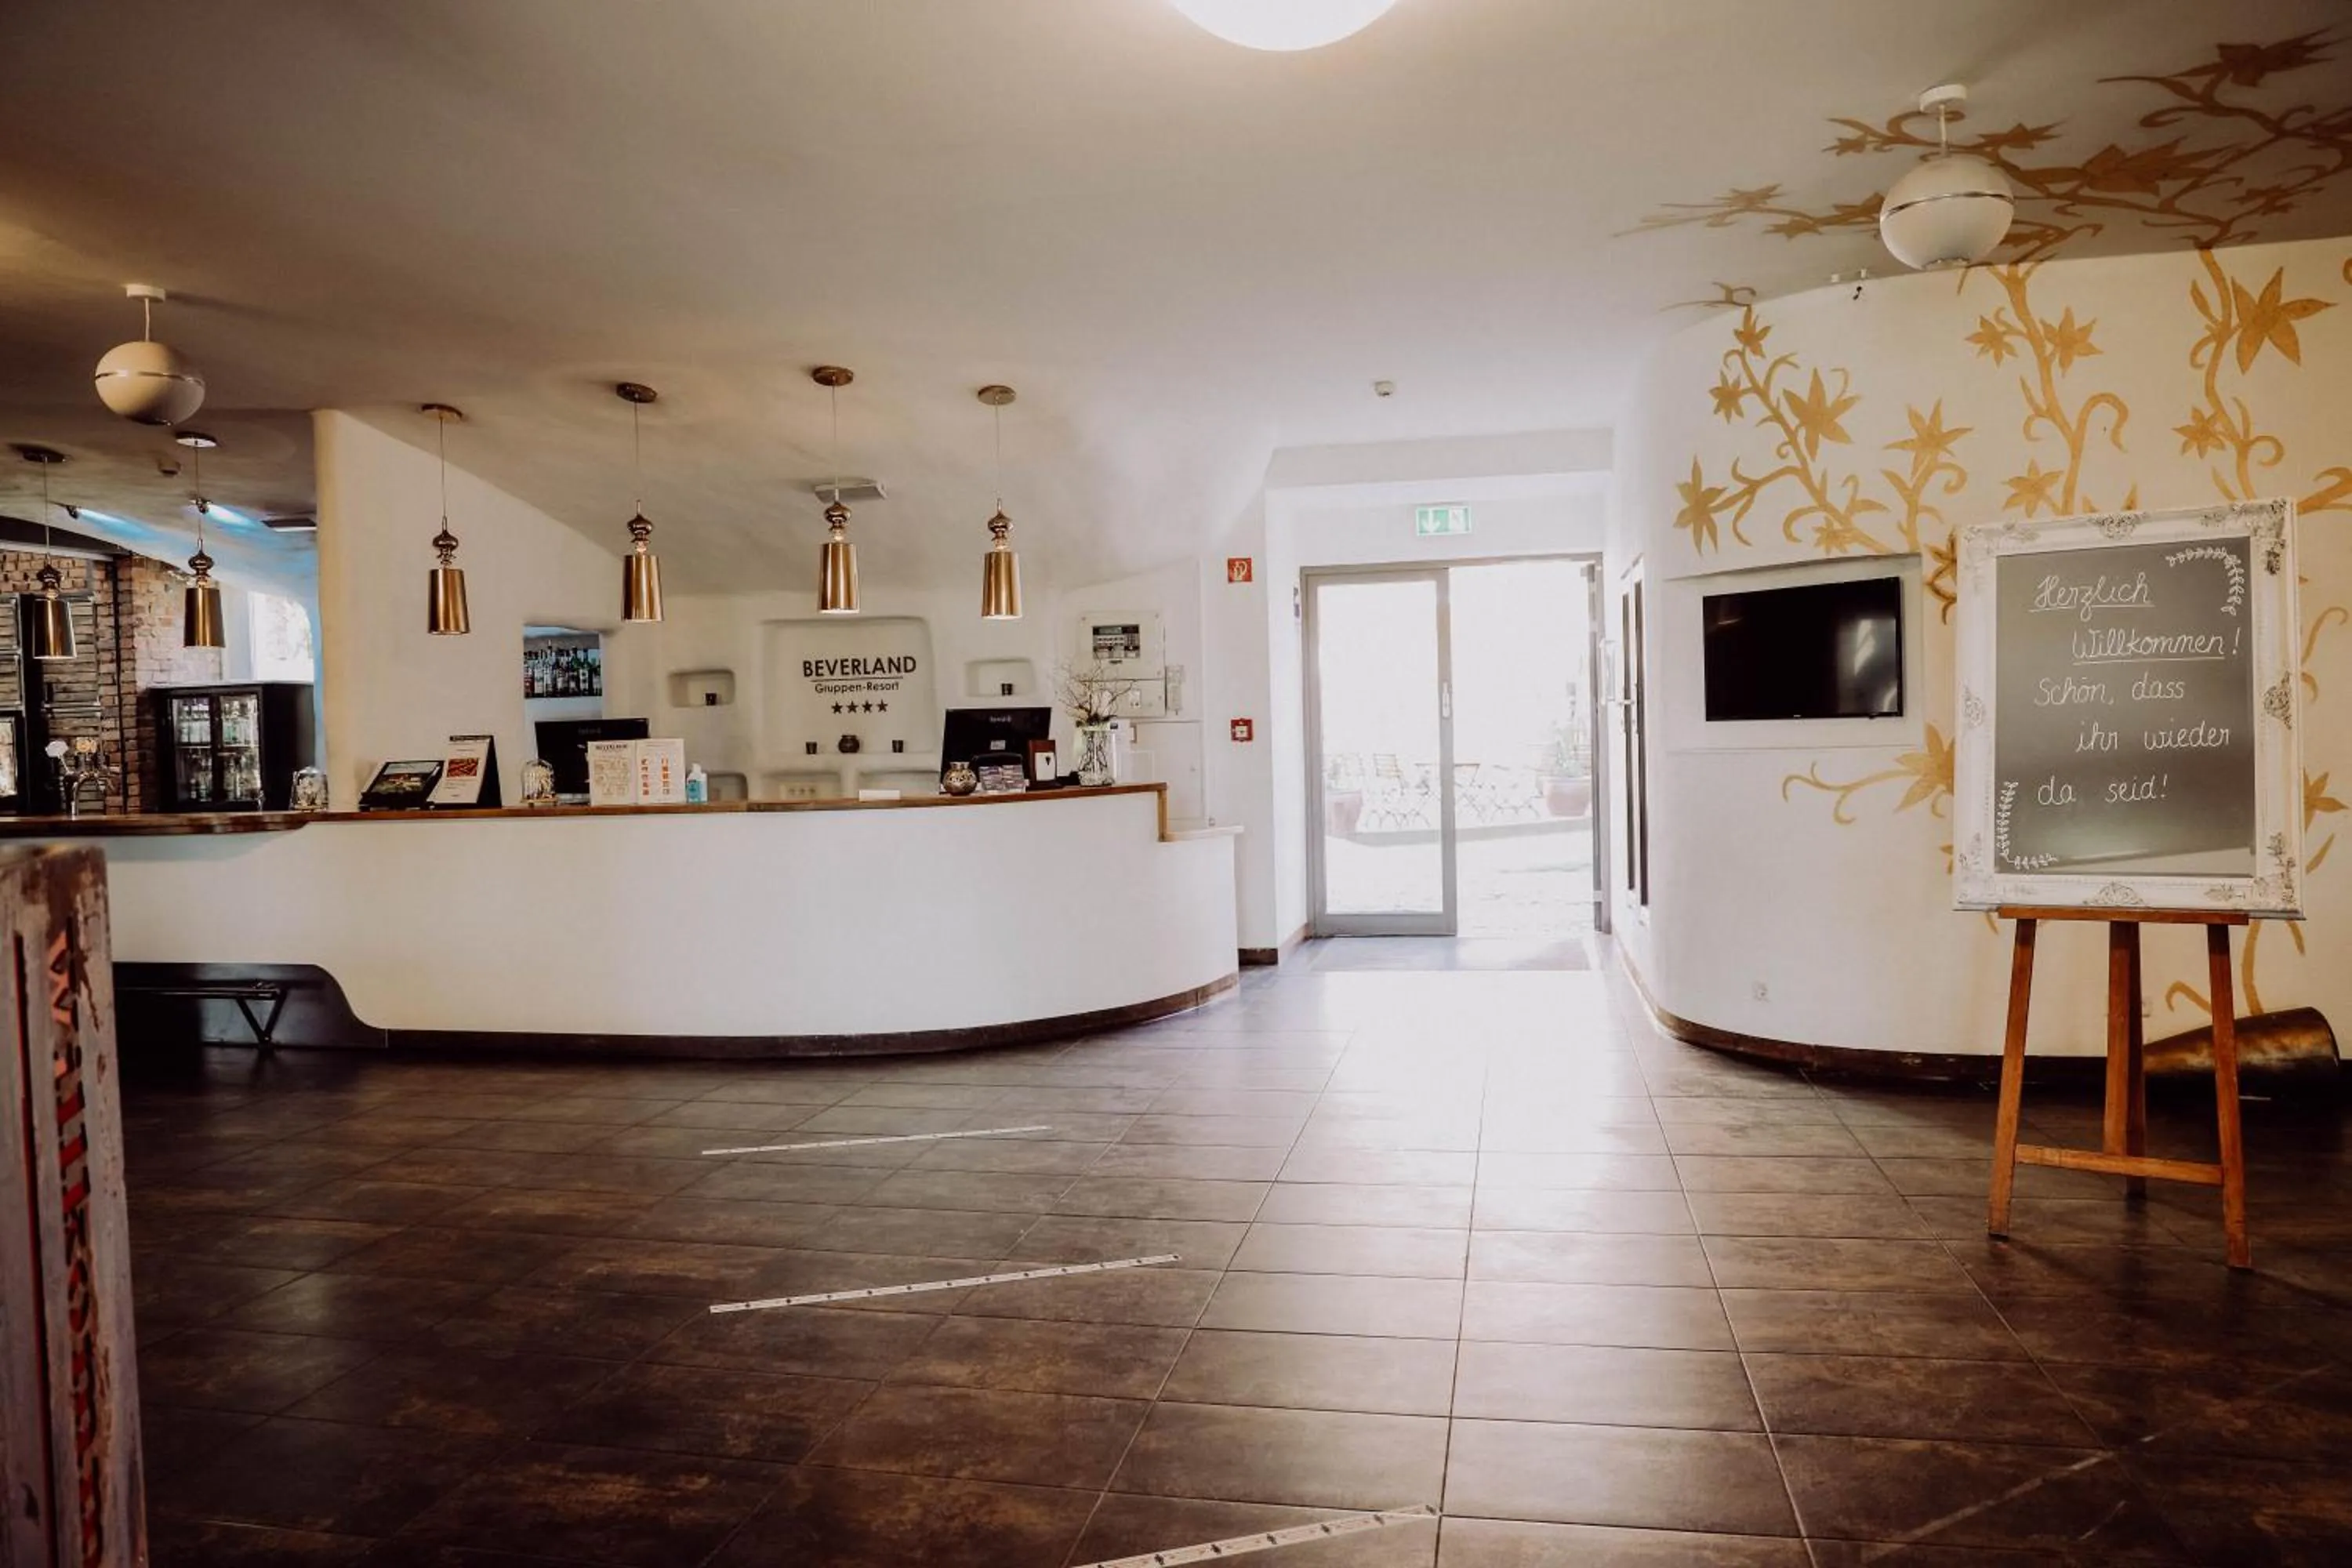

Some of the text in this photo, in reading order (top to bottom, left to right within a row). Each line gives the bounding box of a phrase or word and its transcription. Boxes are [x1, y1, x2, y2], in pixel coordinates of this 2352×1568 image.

[2034, 572, 2151, 622] Herzlich
[802, 656, 916, 677] BEVERLAND
[815, 681, 899, 695] Gruppen-Resort
[2132, 671, 2186, 700] dass
[2076, 717, 2230, 753] ihr wieder
[2038, 773, 2168, 805] da seid!
